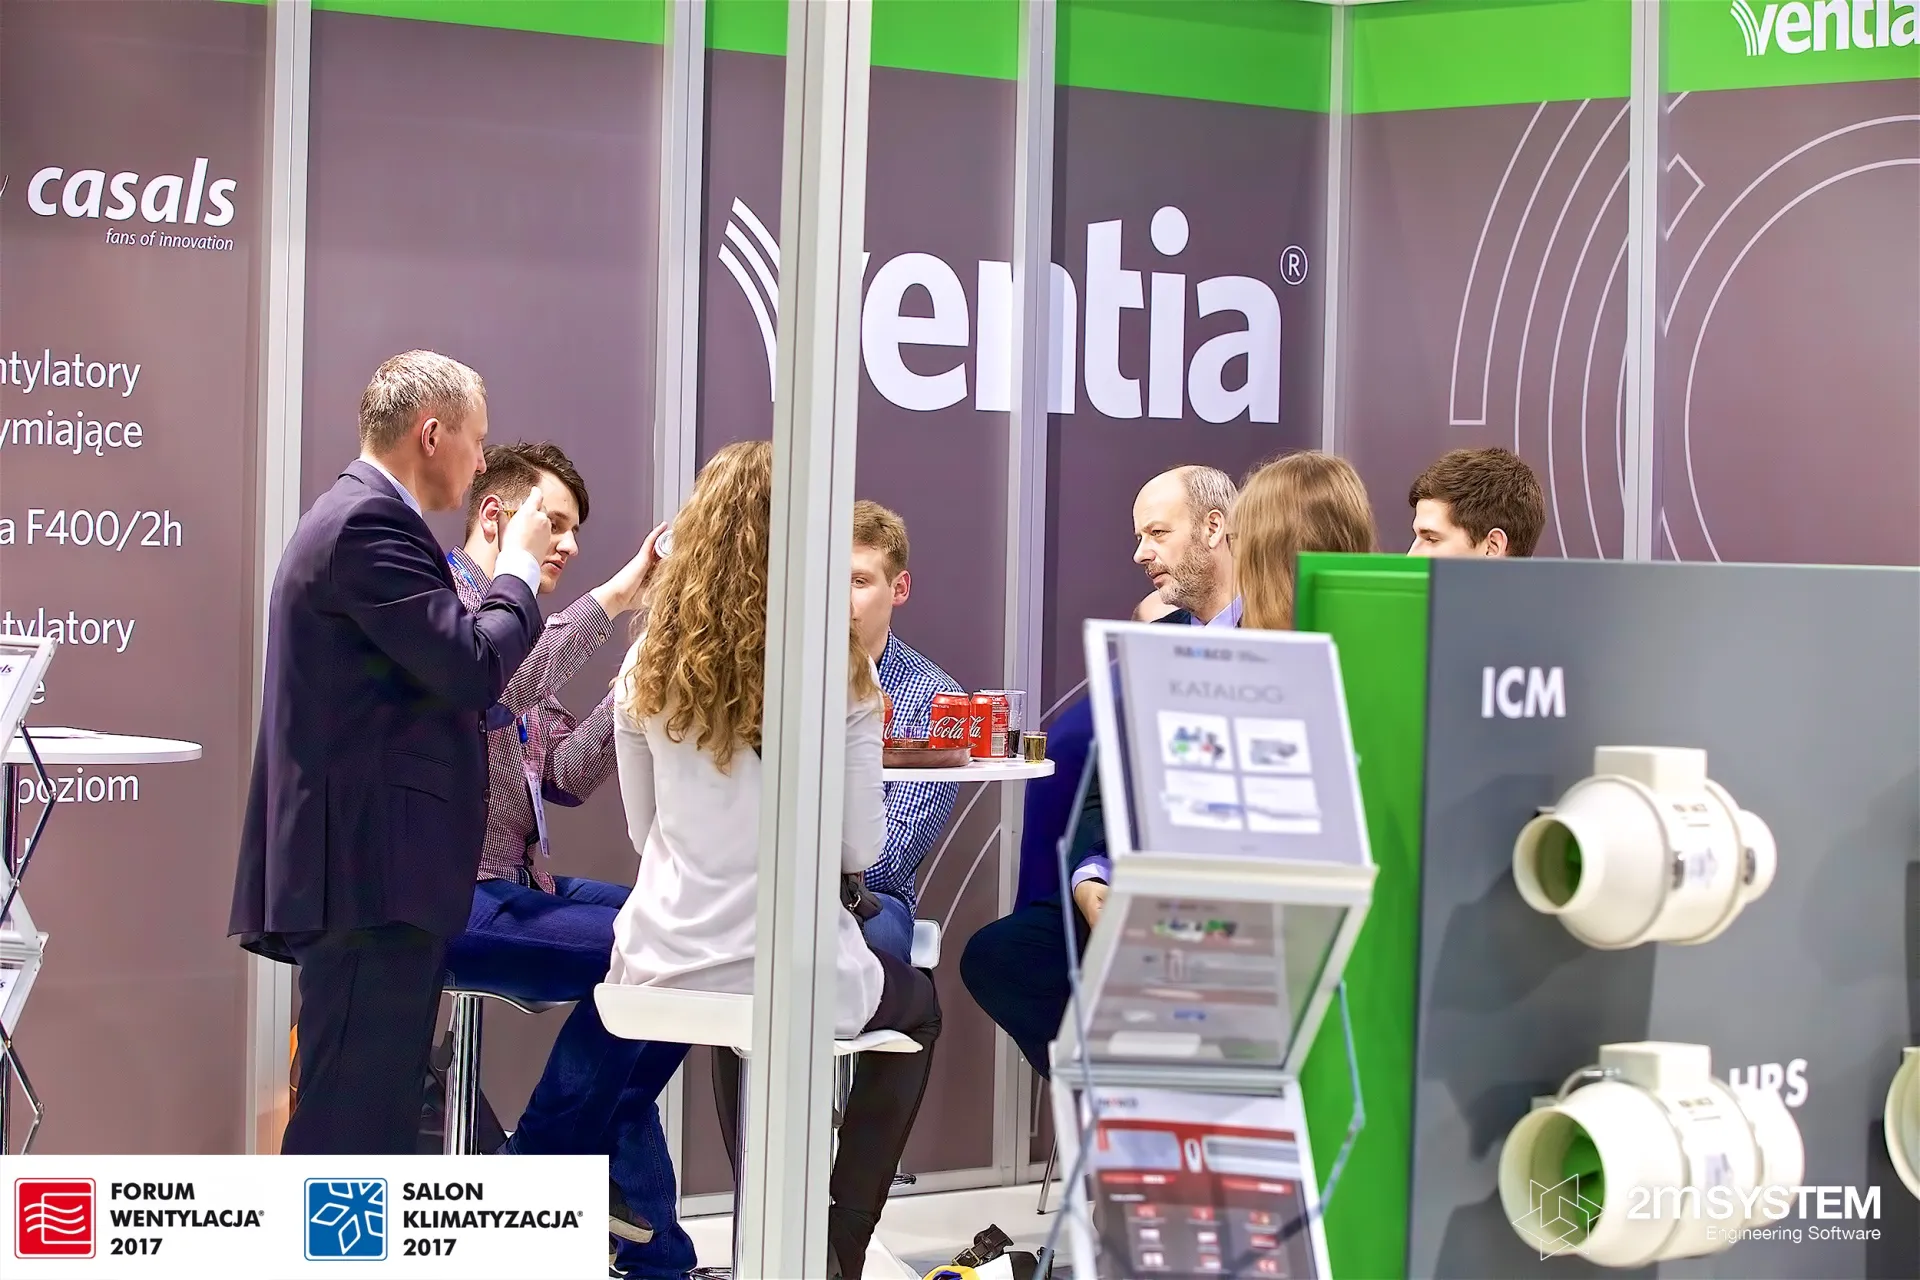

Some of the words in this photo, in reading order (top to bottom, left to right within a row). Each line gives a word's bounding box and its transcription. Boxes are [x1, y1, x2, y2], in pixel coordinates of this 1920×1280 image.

[27, 157, 237, 227] casals
[106, 227, 136, 246] fans
[140, 230, 157, 247] of
[159, 231, 234, 251] innovation
[27, 508, 184, 553] F400/2h
[1169, 679, 1285, 705] KATALOG
[1481, 666, 1567, 719] ICM
